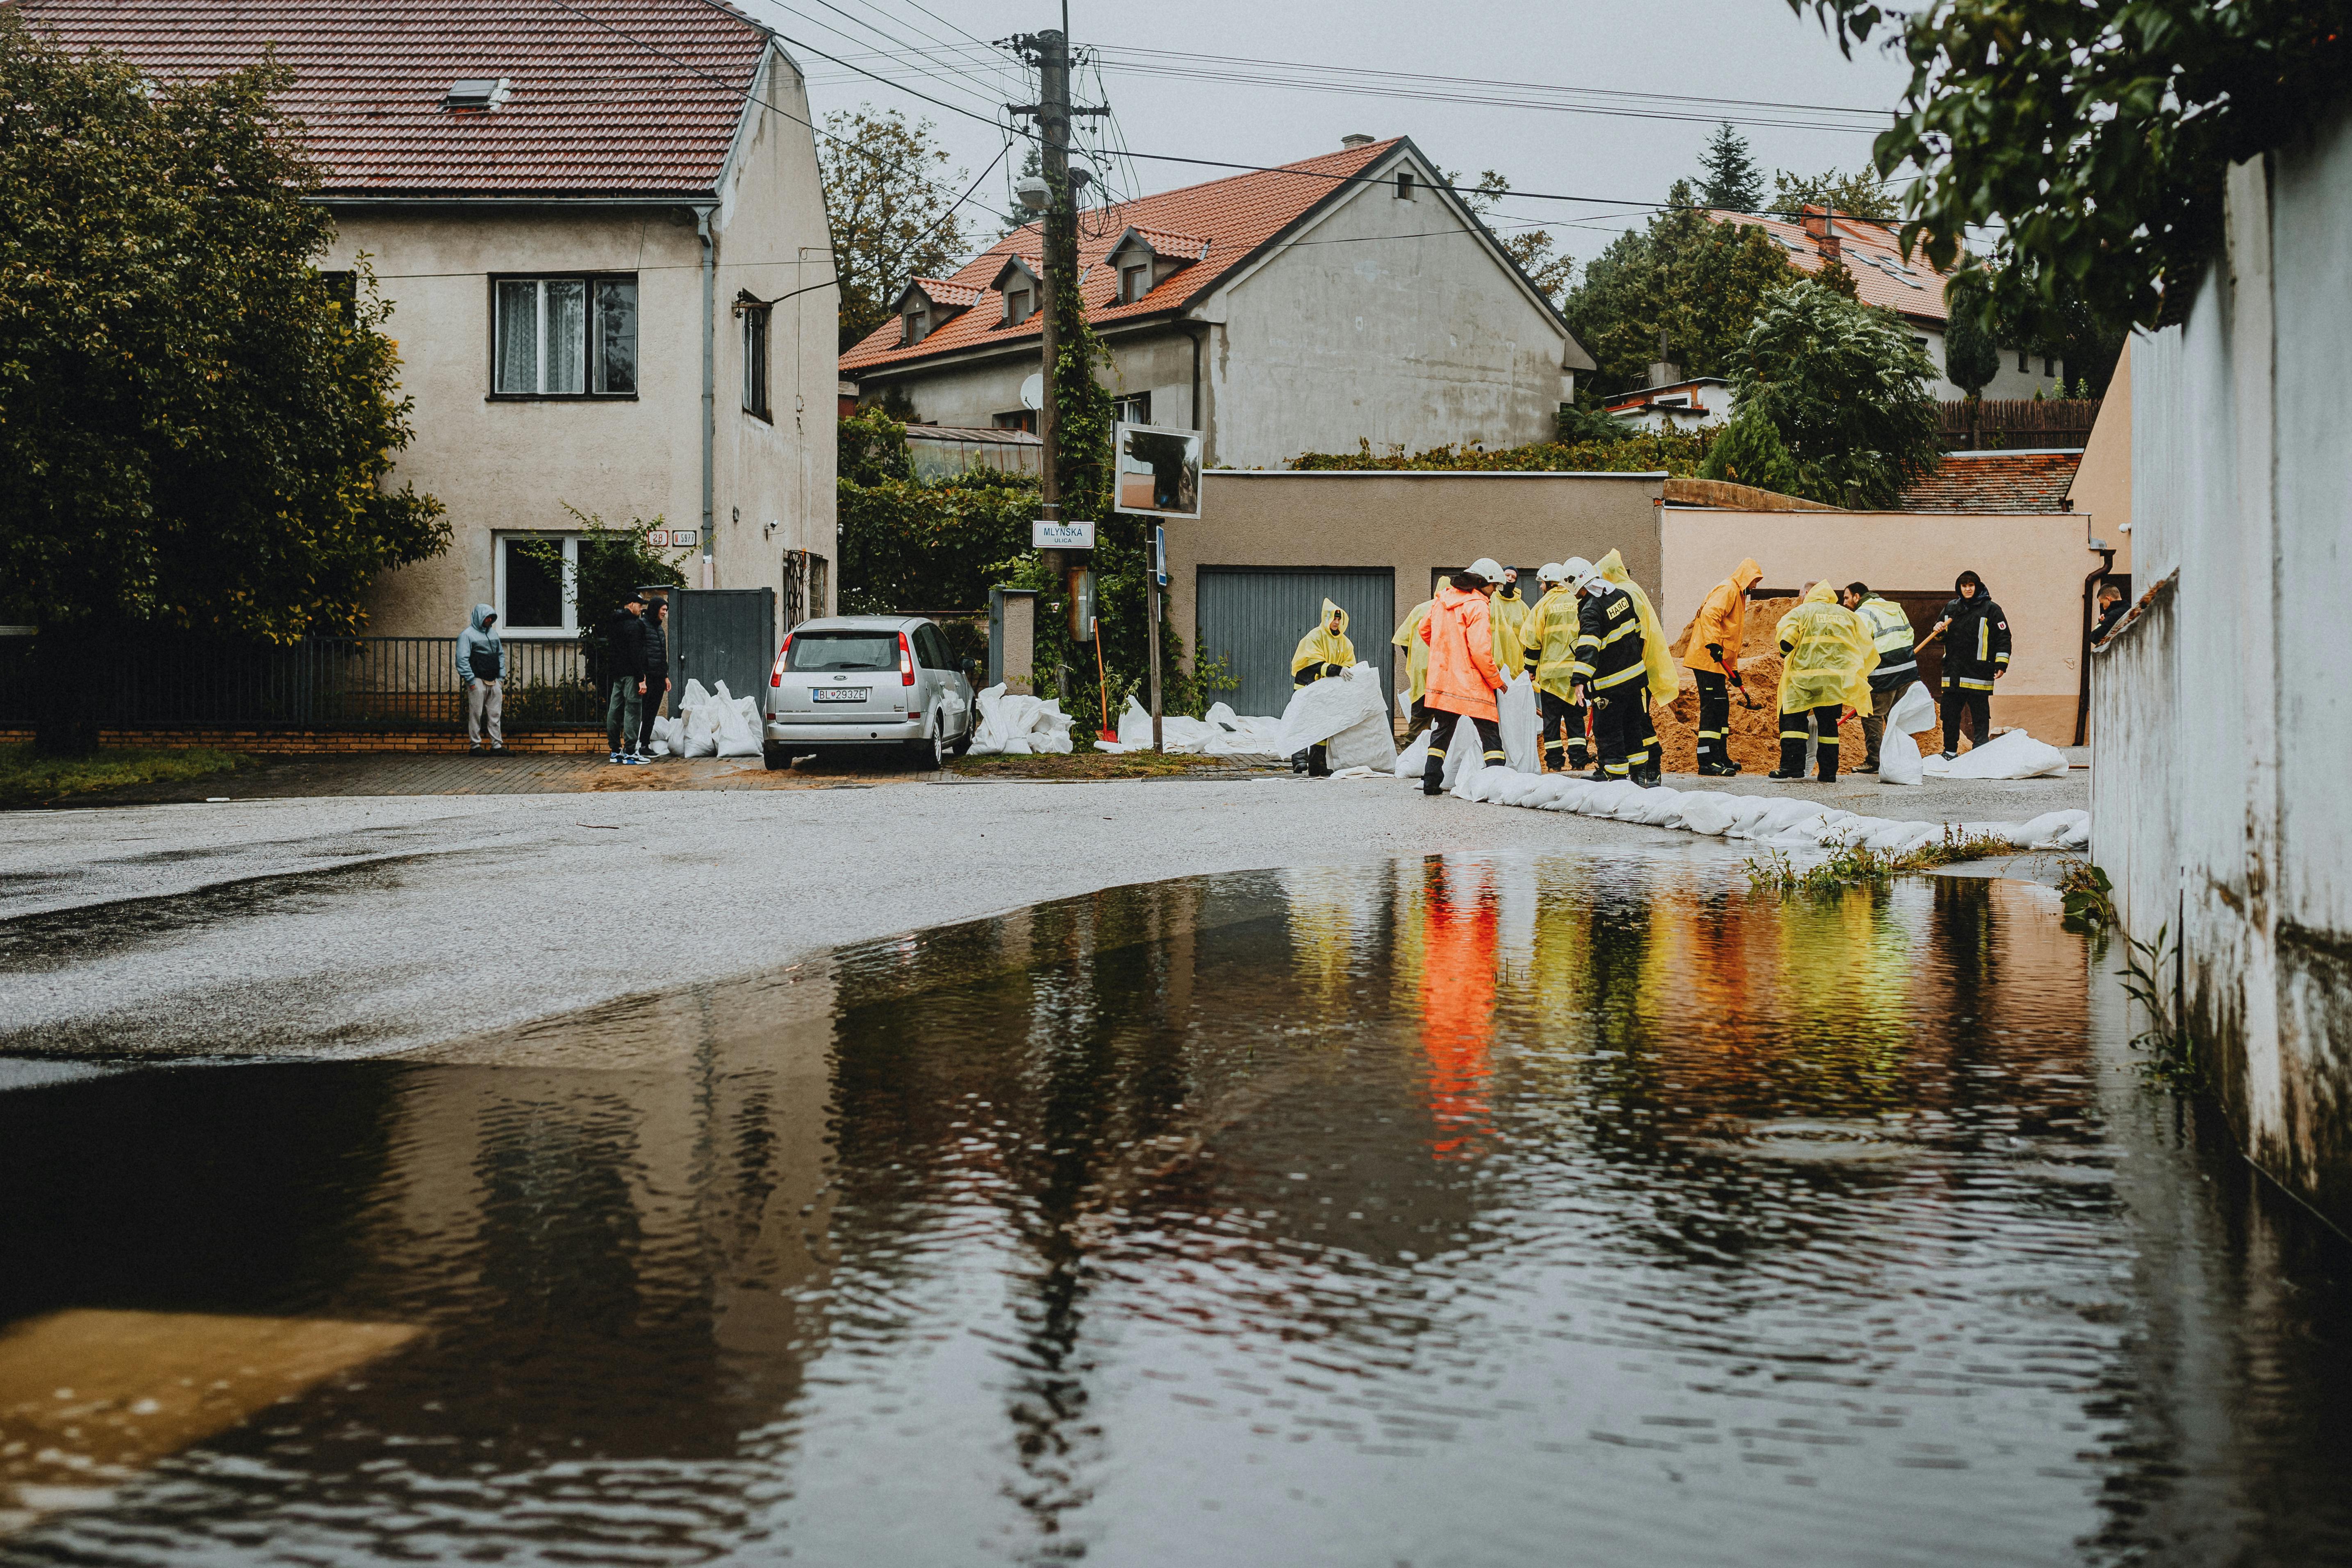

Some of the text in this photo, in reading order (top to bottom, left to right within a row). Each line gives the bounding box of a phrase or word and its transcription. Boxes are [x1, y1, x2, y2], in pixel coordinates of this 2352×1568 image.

[1044, 526, 1082, 536] MLYNSKÁ
[653, 534, 662, 542] 28
[681, 534, 694, 542] 5977
[820, 690, 864, 699] BL 293ZE
